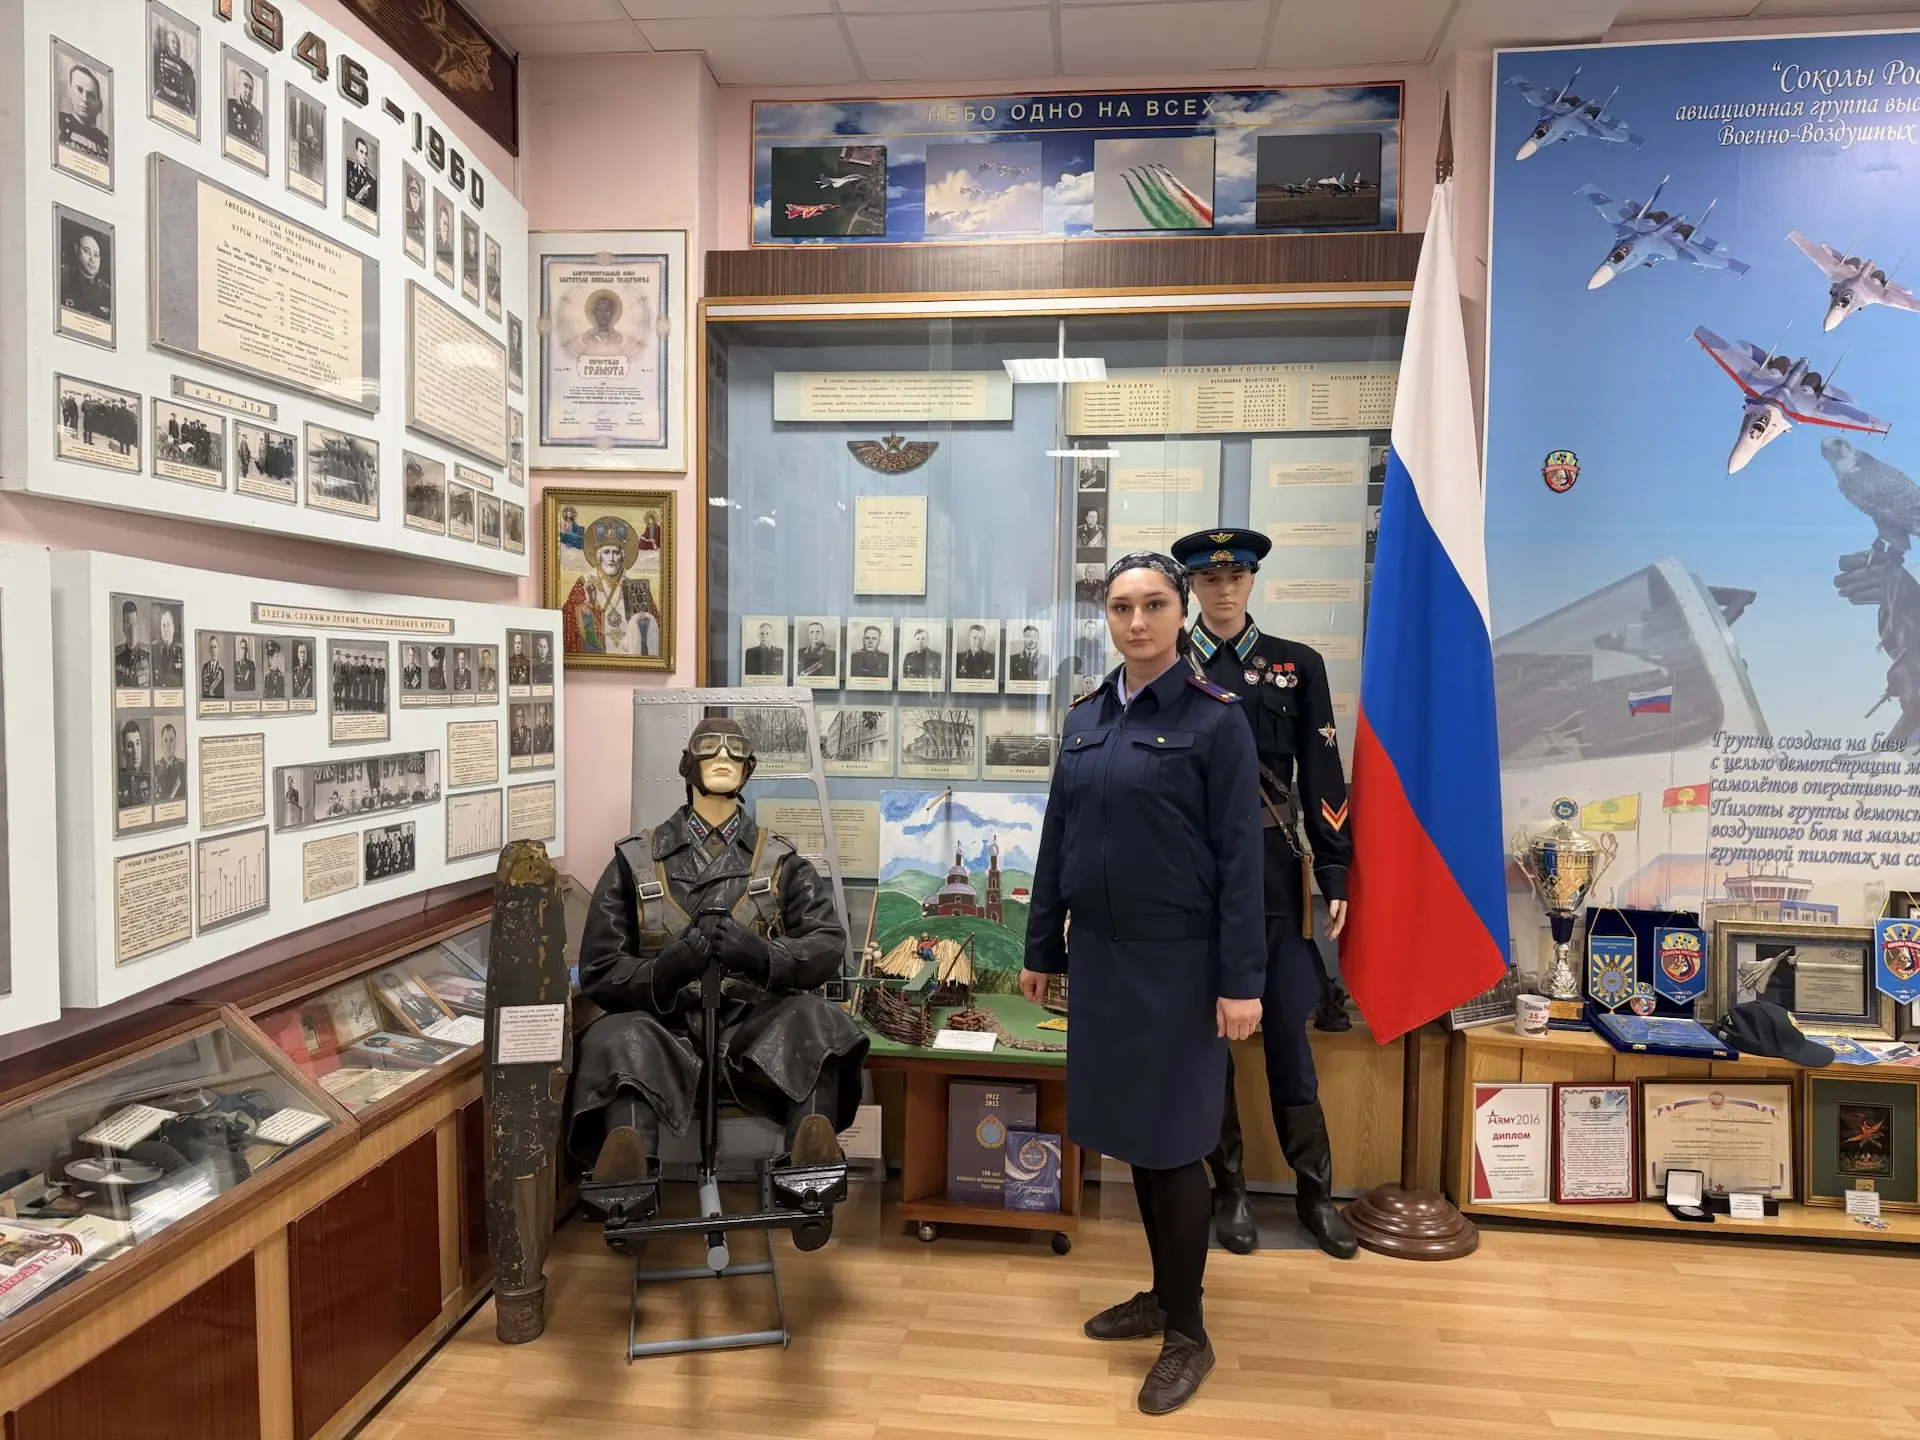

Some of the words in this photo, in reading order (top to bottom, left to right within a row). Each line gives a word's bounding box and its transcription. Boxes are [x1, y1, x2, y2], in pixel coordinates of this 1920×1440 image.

[927, 105, 996, 123] НЕБО
[1011, 102, 1083, 122] ОДНО
[1099, 101, 1131, 117] НА
[1146, 99, 1216, 116] ВСЕХ
[1675, 100, 1805, 124] авиационная
[1810, 97, 1878, 122] группа
[1718, 119, 1918, 149] Военно-Воздушных
[583, 365, 625, 377] ГРАМОТА
[1162, 366, 1233, 374] РУКОВОДЯЩИЙ
[195, 388, 233, 405] ИДУТ
[241, 400, 263, 413] ЛТУ
[294, 612, 324, 622] СЛУЖБЫ
[332, 615, 359, 624] ЛЕТНЫЕ
[363, 618, 384, 626] ЧАСТИ
[385, 619, 418, 628] ЛИПЕЦКИХ
[420, 621, 445, 630] КУРСОВ
[1712, 730, 1774, 755] Группа
[1776, 729, 1843, 751] создана
[1845, 736, 1867, 751] на
[1869, 731, 1907, 752] базе
[1710, 756, 1720, 769] с
[1723, 756, 1775, 774] целью
[1777, 752, 1901, 780] демонстрации
[1710, 776, 1798, 793] самолётов
[1710, 798, 1783, 818] Пилоты
[1787, 804, 1849, 825] группы
[1710, 819, 1805, 844] воздушного
[1808, 821, 1838, 842] боя
[1842, 829, 1863, 843] на
[1709, 845, 1794, 866] групповой
[1797, 851, 1880, 869] пилотаж
[1880, 853, 1901, 867] на
[1492, 1132, 1531, 1141] ДИПЛОМ
[957, 1176, 1005, 1184] ВОЕННО-ВОЗДУШНЫ
